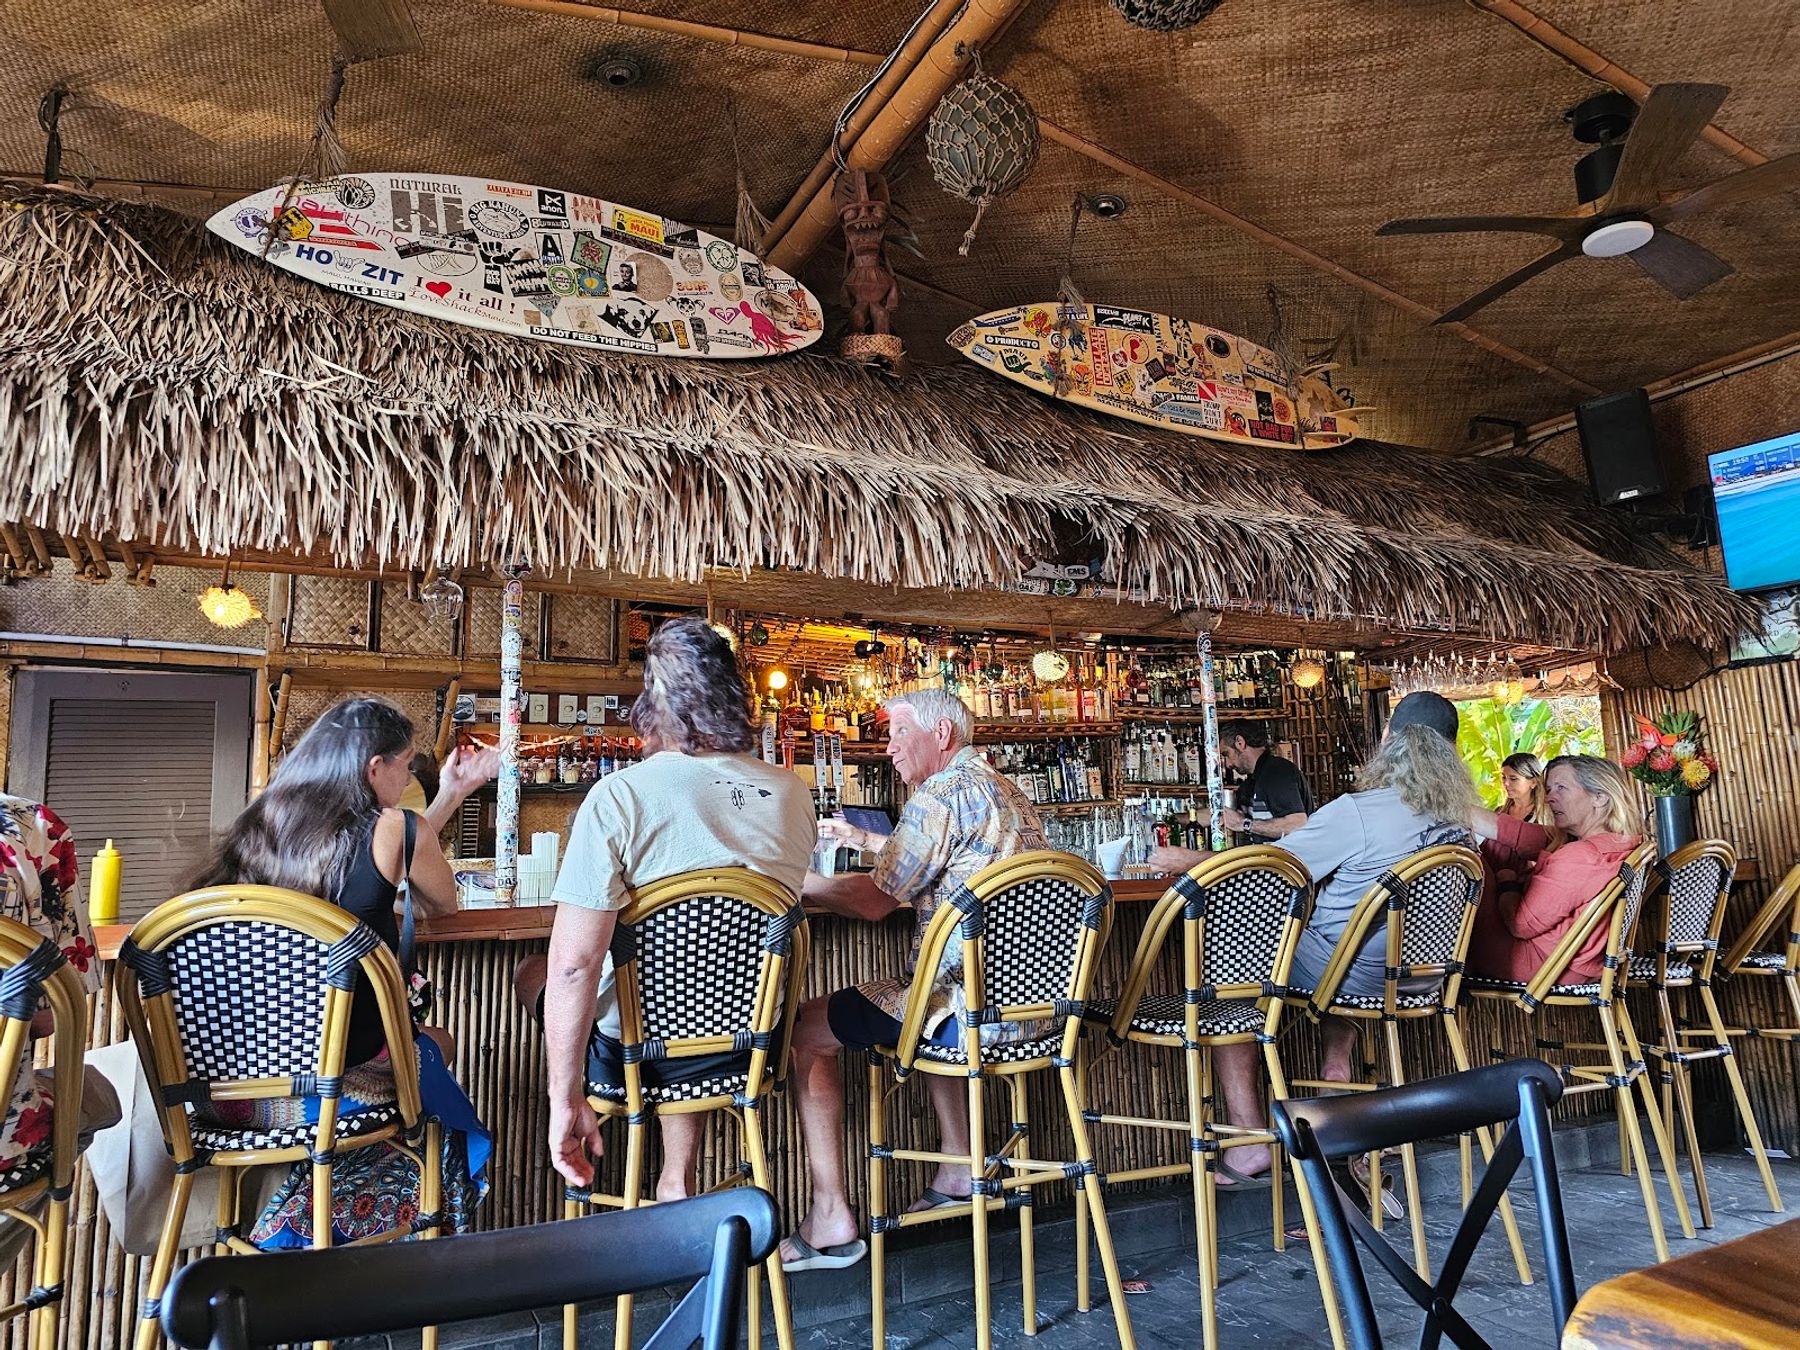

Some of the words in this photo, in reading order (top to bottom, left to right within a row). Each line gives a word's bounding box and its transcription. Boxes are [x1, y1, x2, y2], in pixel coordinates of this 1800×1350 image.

[472, 201, 487, 214] BIG
[488, 200, 526, 223] KAHUNA
[630, 222, 659, 237] MAUI
[372, 286, 403, 299] DEEP
[479, 297, 503, 312] all
[533, 327, 545, 336] DO
[549, 330, 570, 340] NOT
[573, 332, 597, 344] FEED
[599, 336, 619, 346] THE
[620, 339, 657, 352] HIPPIES
[766, 726, 774, 750] ULTRA
